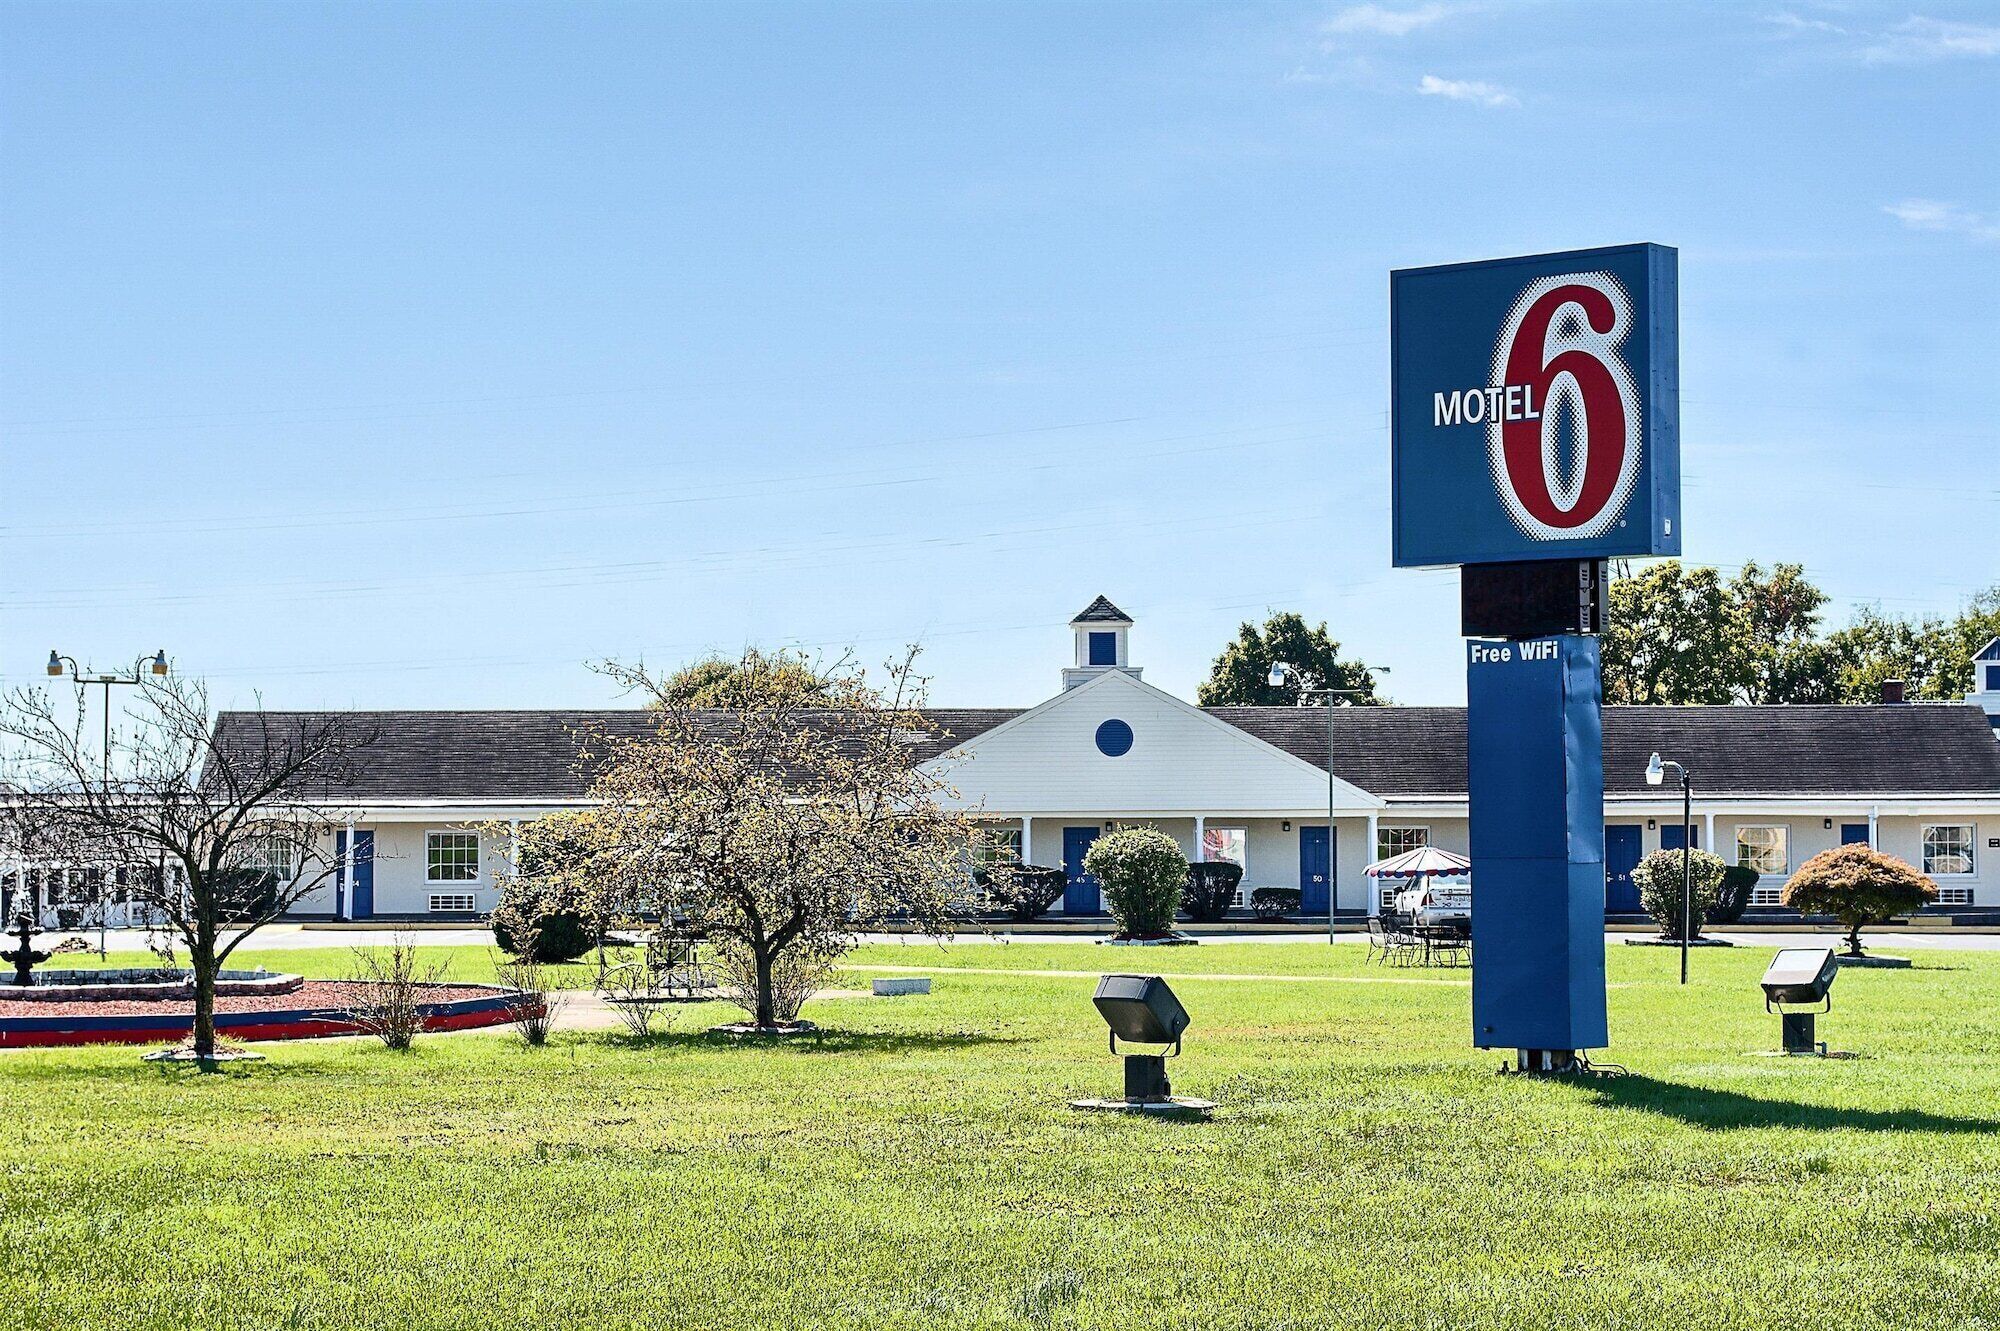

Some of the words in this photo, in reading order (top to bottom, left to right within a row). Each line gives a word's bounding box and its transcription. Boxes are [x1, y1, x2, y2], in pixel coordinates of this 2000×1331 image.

[1434, 384, 1540, 427] MOTEL
[1502, 284, 1626, 529] 6
[1471, 645, 1512, 664] Free
[1519, 640, 1558, 661] WiFi
[1313, 875, 1323, 883] 50
